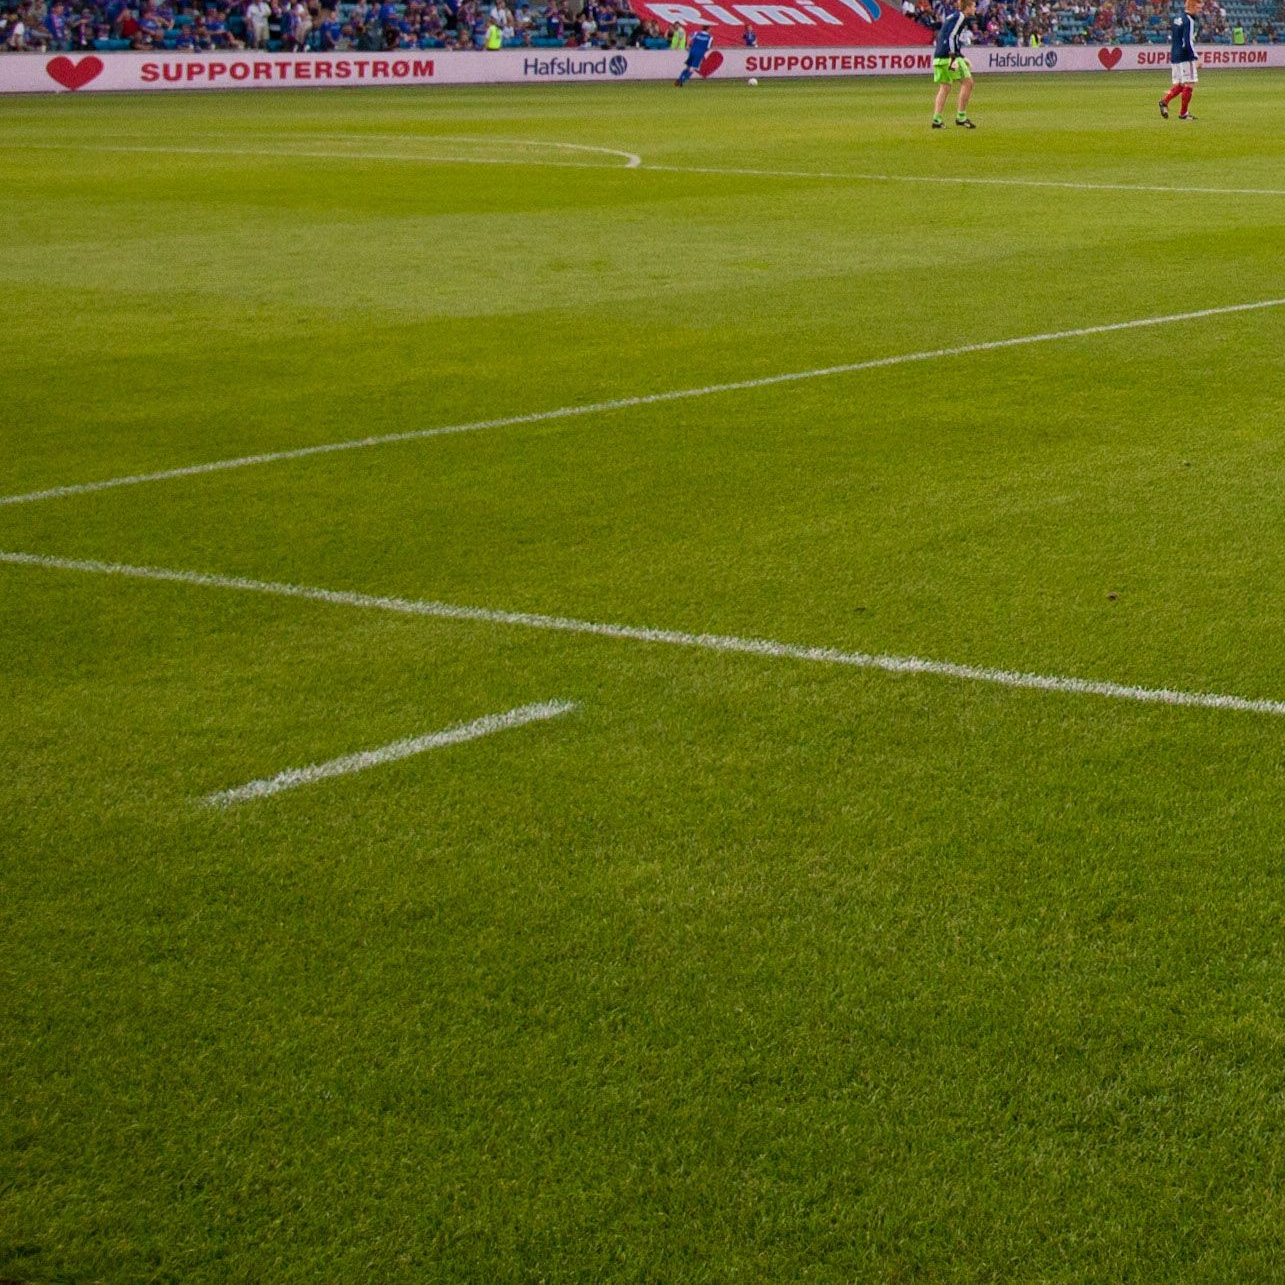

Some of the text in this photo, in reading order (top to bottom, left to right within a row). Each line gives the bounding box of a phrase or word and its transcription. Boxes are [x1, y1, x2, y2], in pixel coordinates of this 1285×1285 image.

[523, 56, 606, 76] Hafslund
[745, 55, 932, 71] SUPPORTERSTRØM
[989, 52, 1043, 68] Hafslund
[140, 60, 435, 82] SUPPORTERSTRØM
